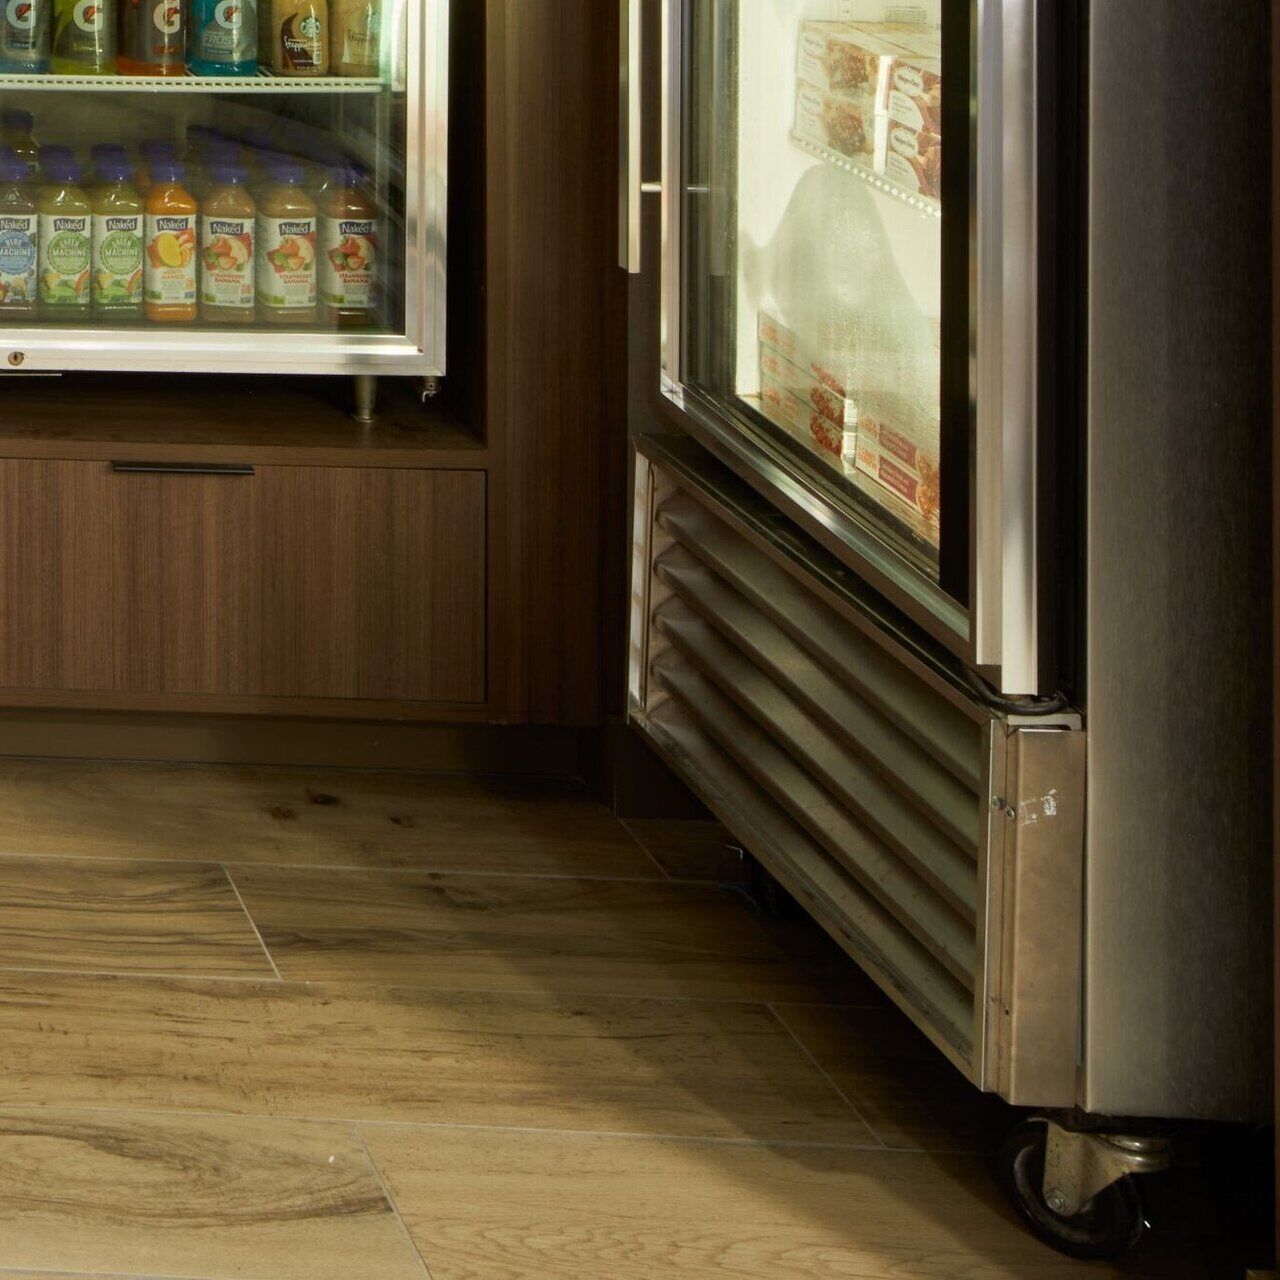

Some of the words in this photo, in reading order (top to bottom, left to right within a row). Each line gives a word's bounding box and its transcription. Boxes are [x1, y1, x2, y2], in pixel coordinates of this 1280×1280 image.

[0, 219, 28, 230] Naked
[56, 219, 84, 230] Naked
[107, 219, 136, 230] Naked
[159, 219, 188, 230] Naked
[213, 223, 242, 234] Naked
[281, 223, 311, 234] Naked
[342, 223, 371, 234] Naked
[52, 248, 87, 257] MACHINE
[105, 248, 139, 257] MACHINE
